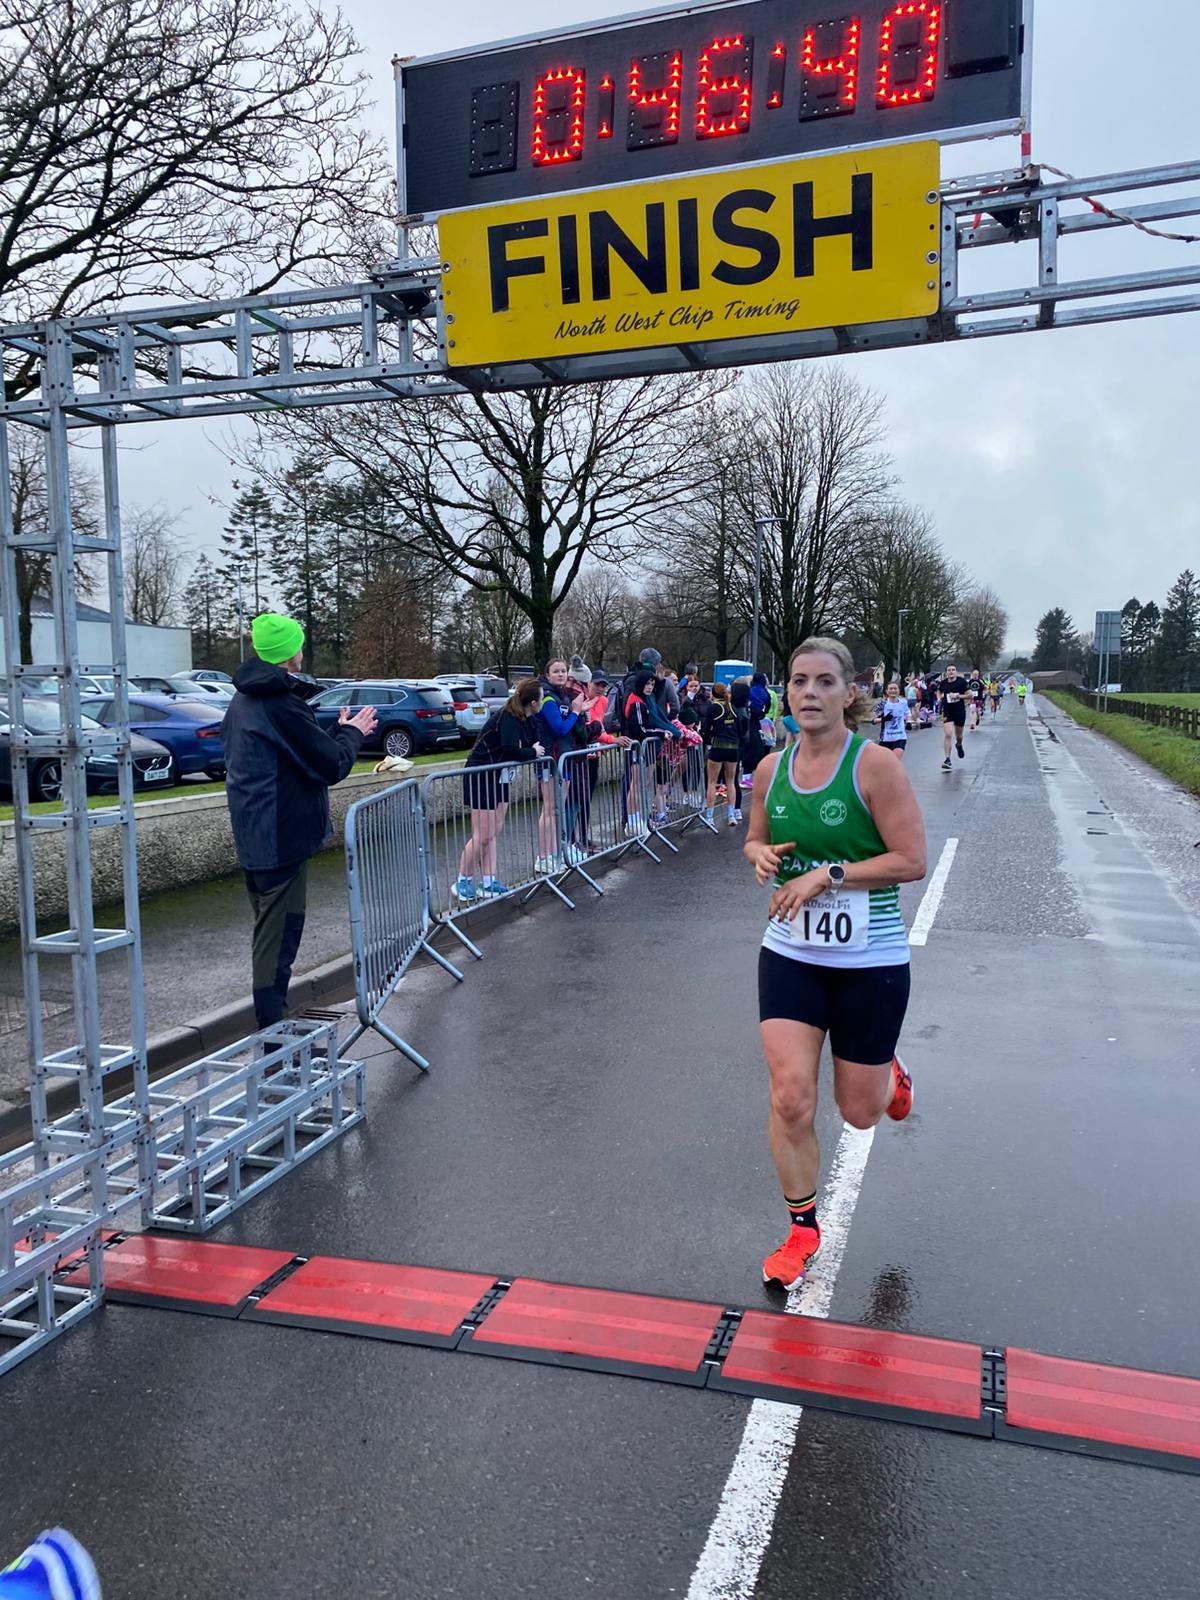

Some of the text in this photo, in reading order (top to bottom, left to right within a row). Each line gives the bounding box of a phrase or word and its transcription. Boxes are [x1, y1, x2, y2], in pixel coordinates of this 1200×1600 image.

[487, 172, 873, 313] FINISH
[554, 298, 801, 339] North West Chip Timing
[803, 910, 852, 944] 140
